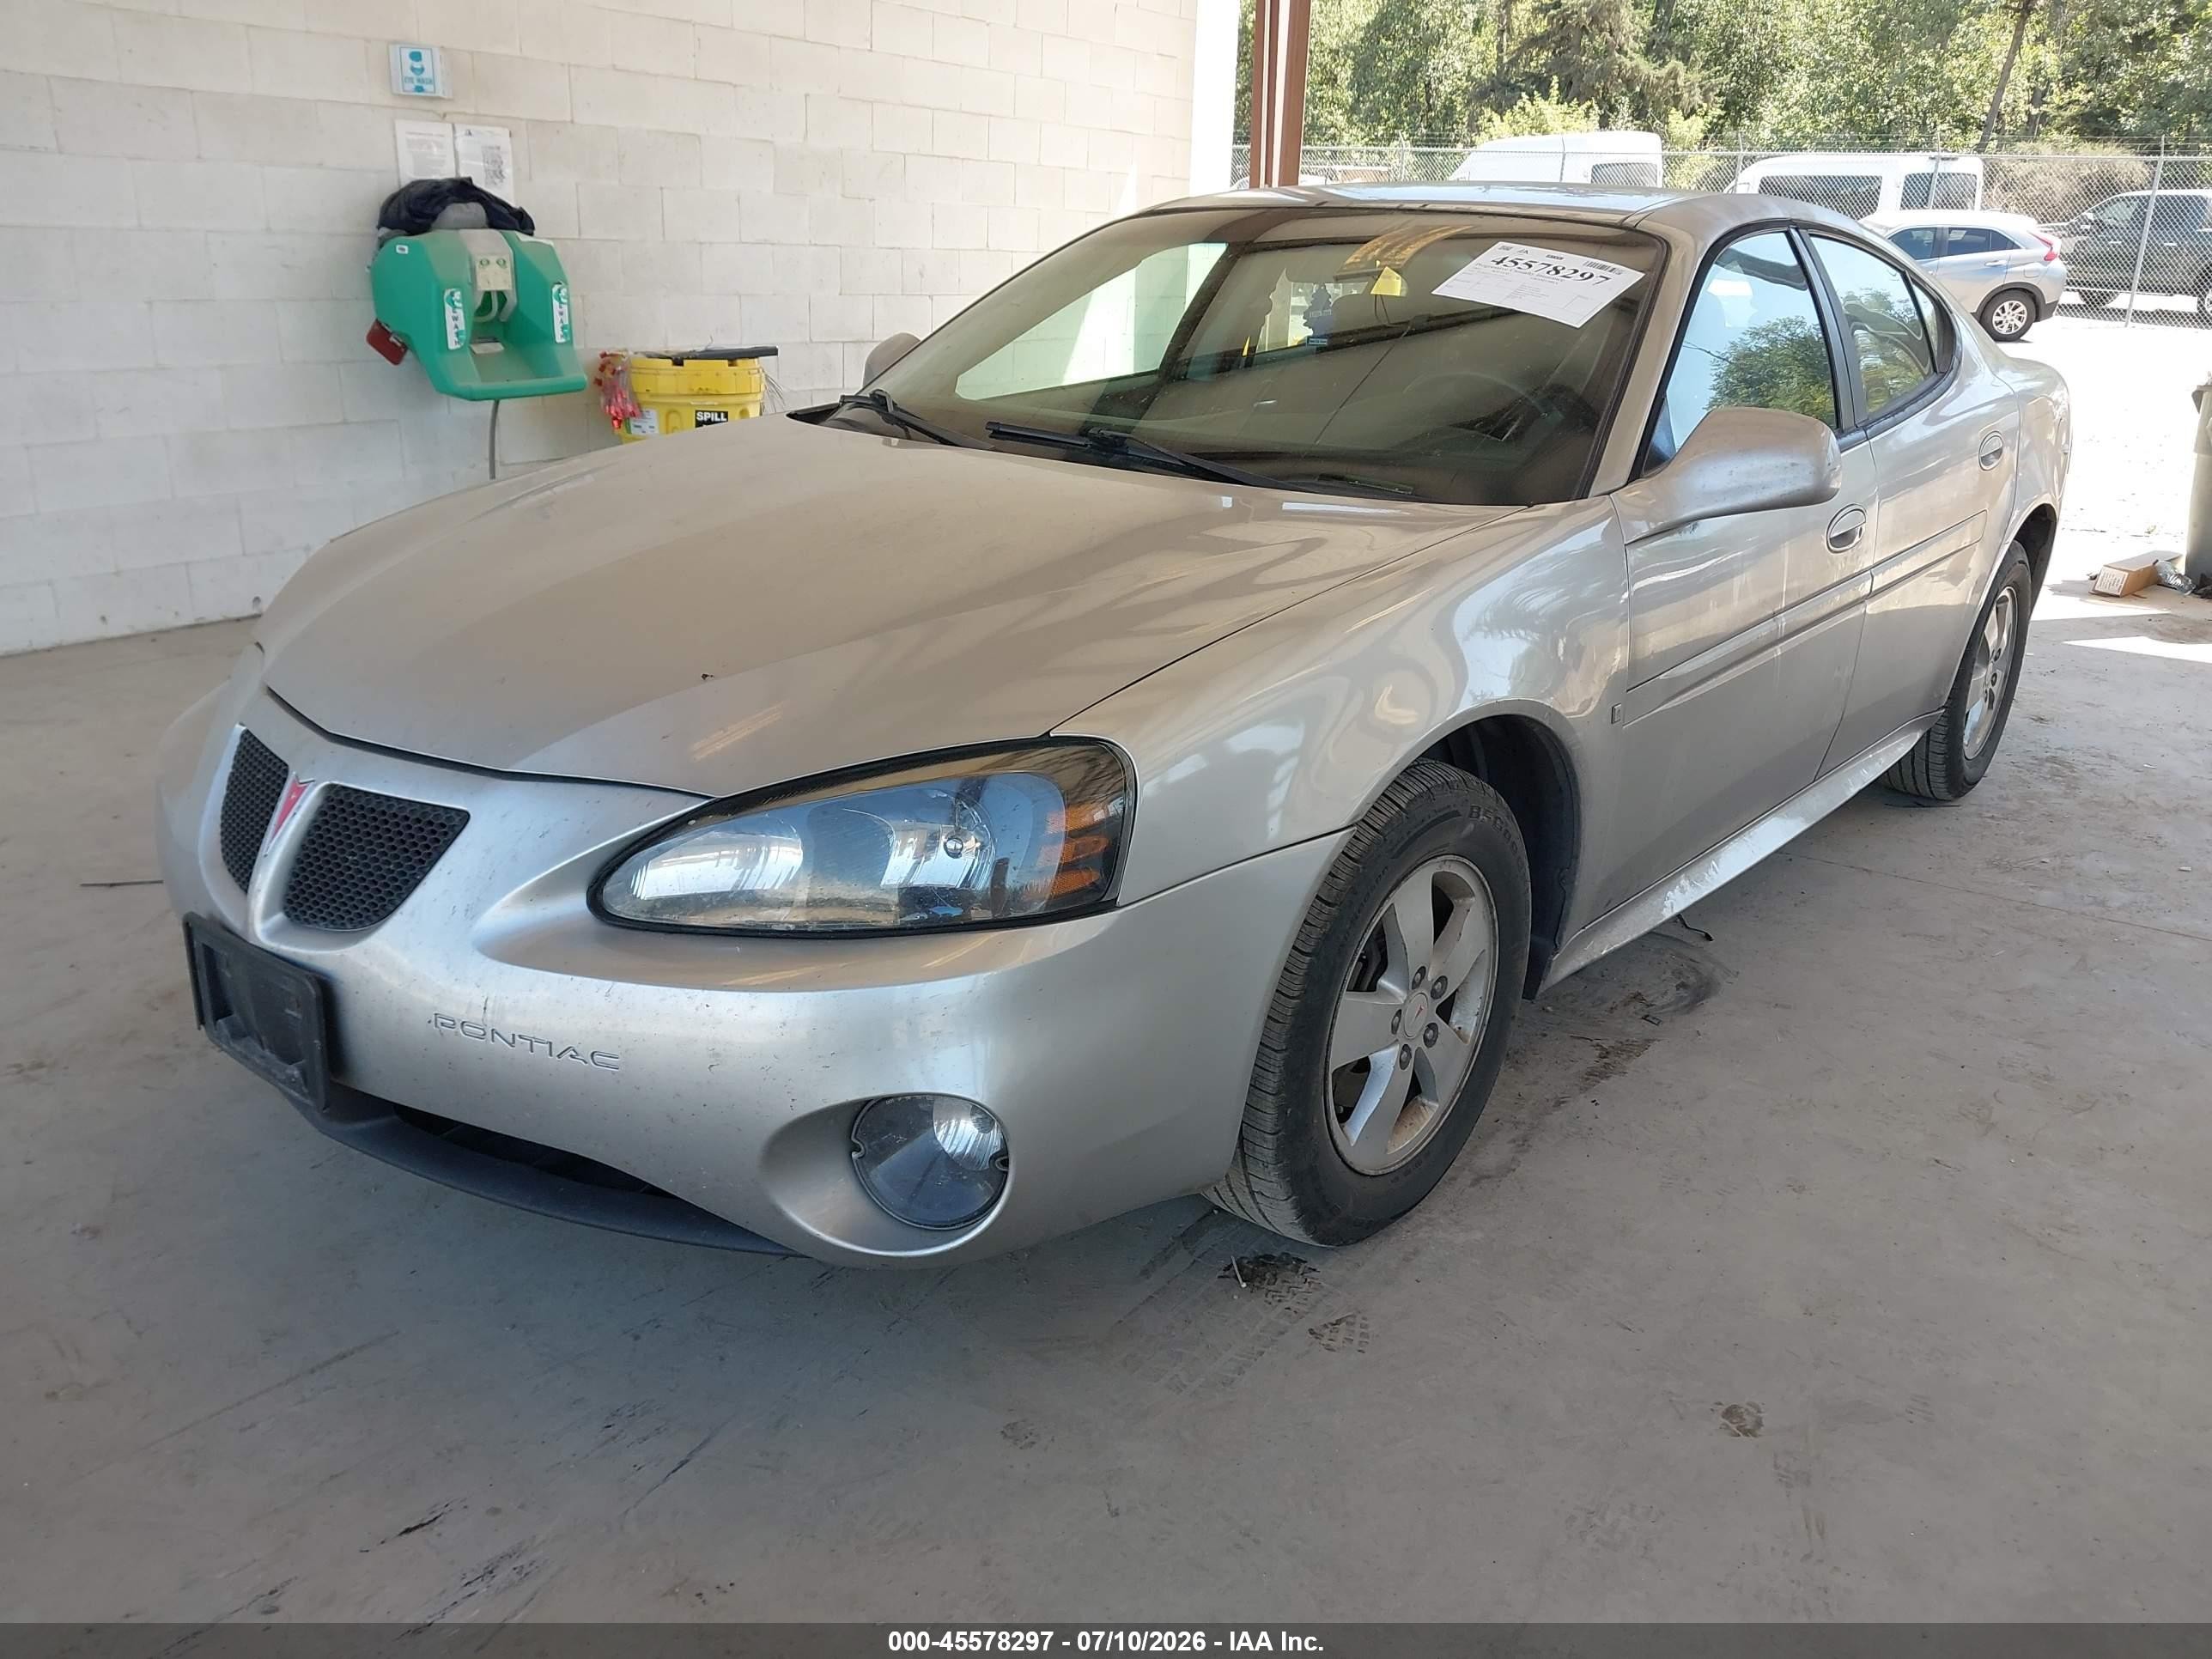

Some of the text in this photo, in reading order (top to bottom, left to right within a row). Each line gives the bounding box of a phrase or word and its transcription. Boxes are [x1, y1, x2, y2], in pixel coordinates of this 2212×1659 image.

[1491, 255, 1612, 285] 45578297
[696, 411, 727, 422] SPILL
[433, 1012, 619, 1071] PONTIAC
